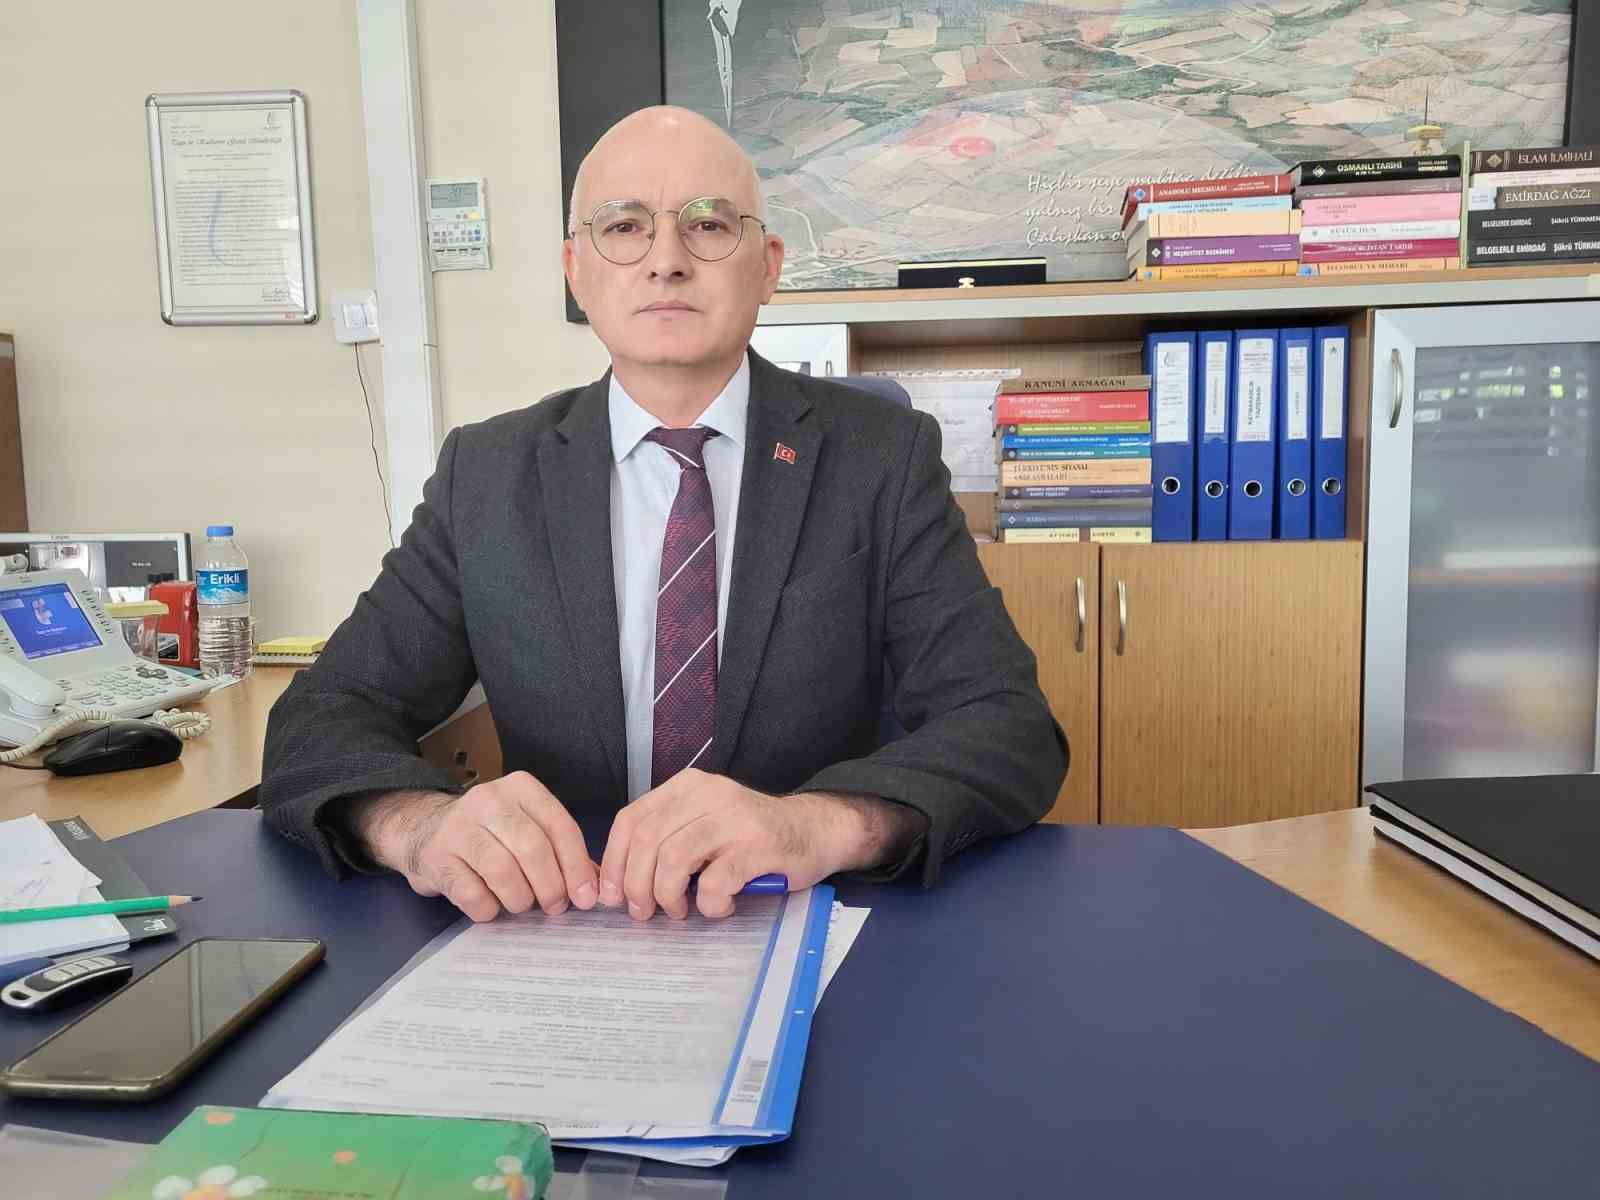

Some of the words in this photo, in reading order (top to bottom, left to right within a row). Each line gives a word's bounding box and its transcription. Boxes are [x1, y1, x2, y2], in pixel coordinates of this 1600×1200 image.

[1518, 153, 1548, 164] İSLAM
[1550, 149, 1593, 163] İLMİHALİ
[1337, 163, 1375, 172] OSMANLI
[1376, 160, 1402, 170] TARİHİ
[1504, 189, 1559, 203] EMİRDAĞ
[1561, 186, 1592, 200] AĞZI
[209, 573, 240, 585] Erikli
